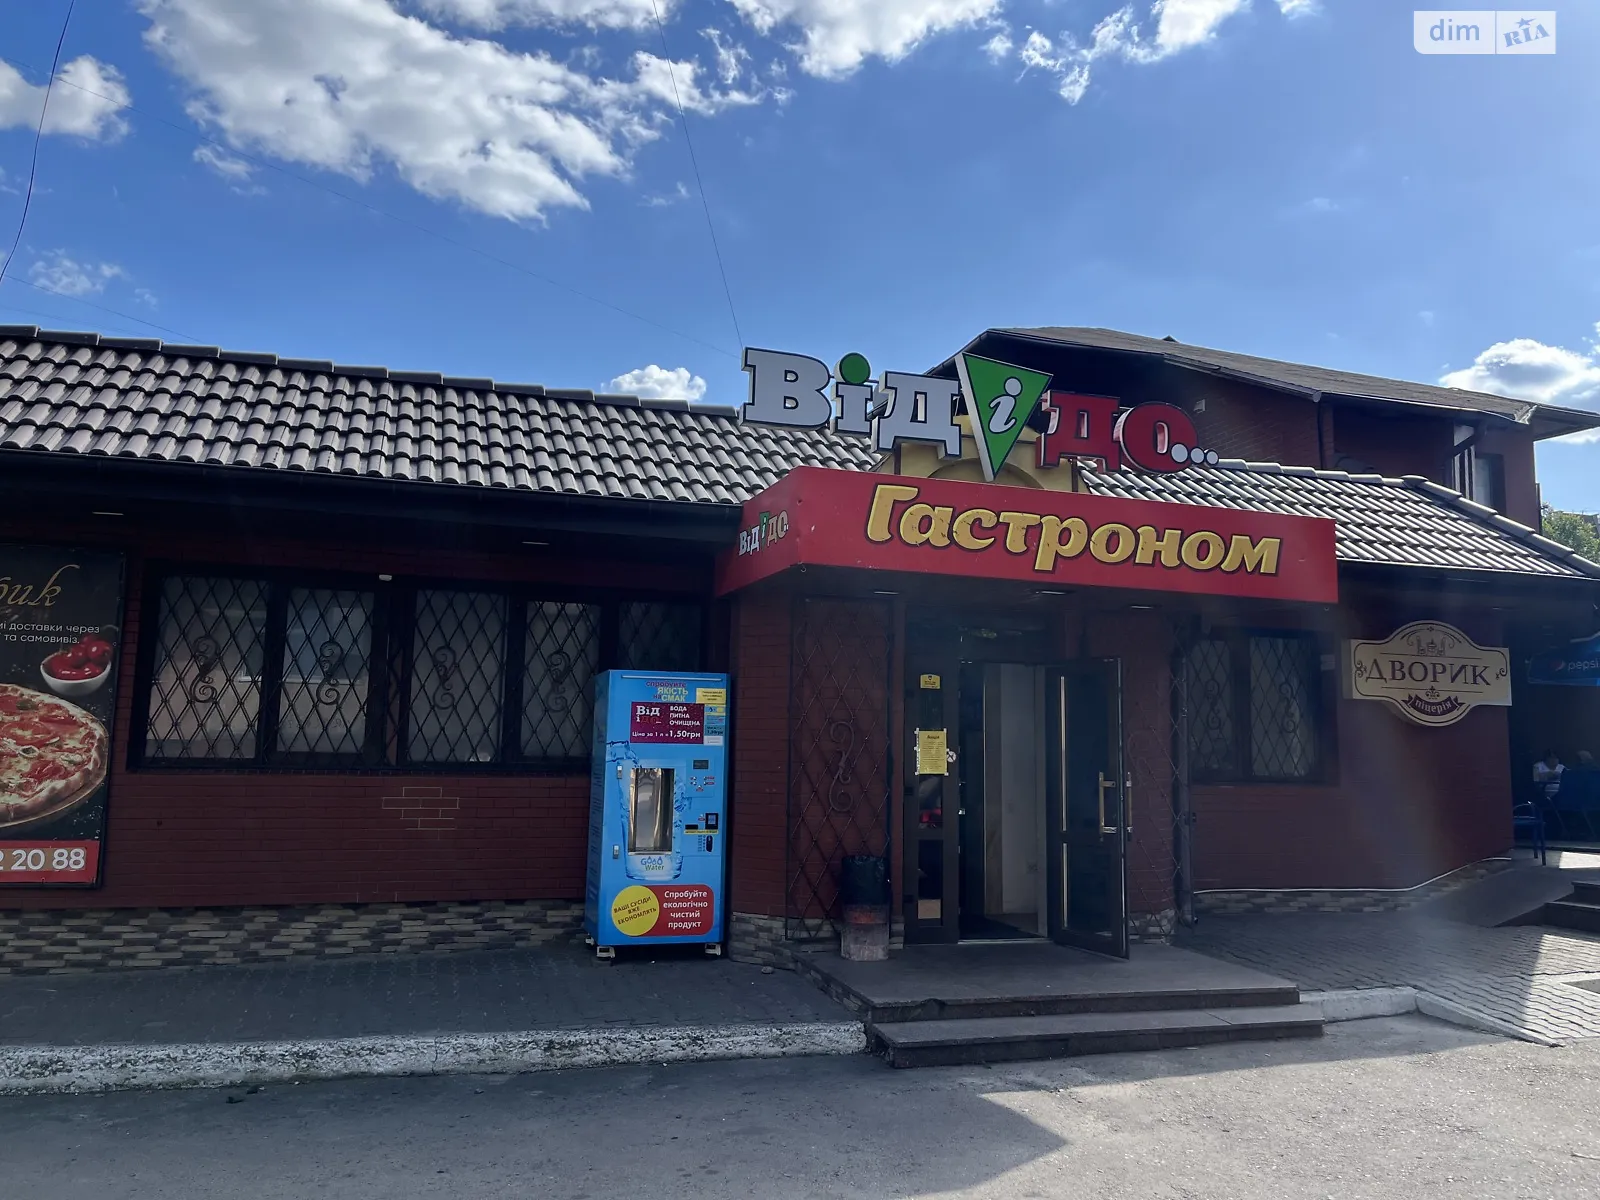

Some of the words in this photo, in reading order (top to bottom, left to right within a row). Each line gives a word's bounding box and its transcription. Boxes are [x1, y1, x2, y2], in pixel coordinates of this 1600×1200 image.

[741, 346, 962, 457] Від
[865, 483, 1281, 577] Гастроном
[9, 623, 63, 631] доставки
[66, 625, 100, 634] через
[20, 635, 80, 644] самовивіз.
[1568, 657, 1599, 672] pepsi
[1365, 658, 1491, 686] ДВОРИК
[657, 687, 688, 695] ЯКІСТЬ
[636, 705, 660, 717] Від
[1414, 699, 1453, 714] піцерія
[11, 849, 46, 870] 20
[52, 848, 86, 870] 88
[664, 890, 708, 900] Спробуйте
[663, 900, 708, 909] екологічно
[670, 910, 701, 918] чистий
[668, 921, 702, 930] продукт
